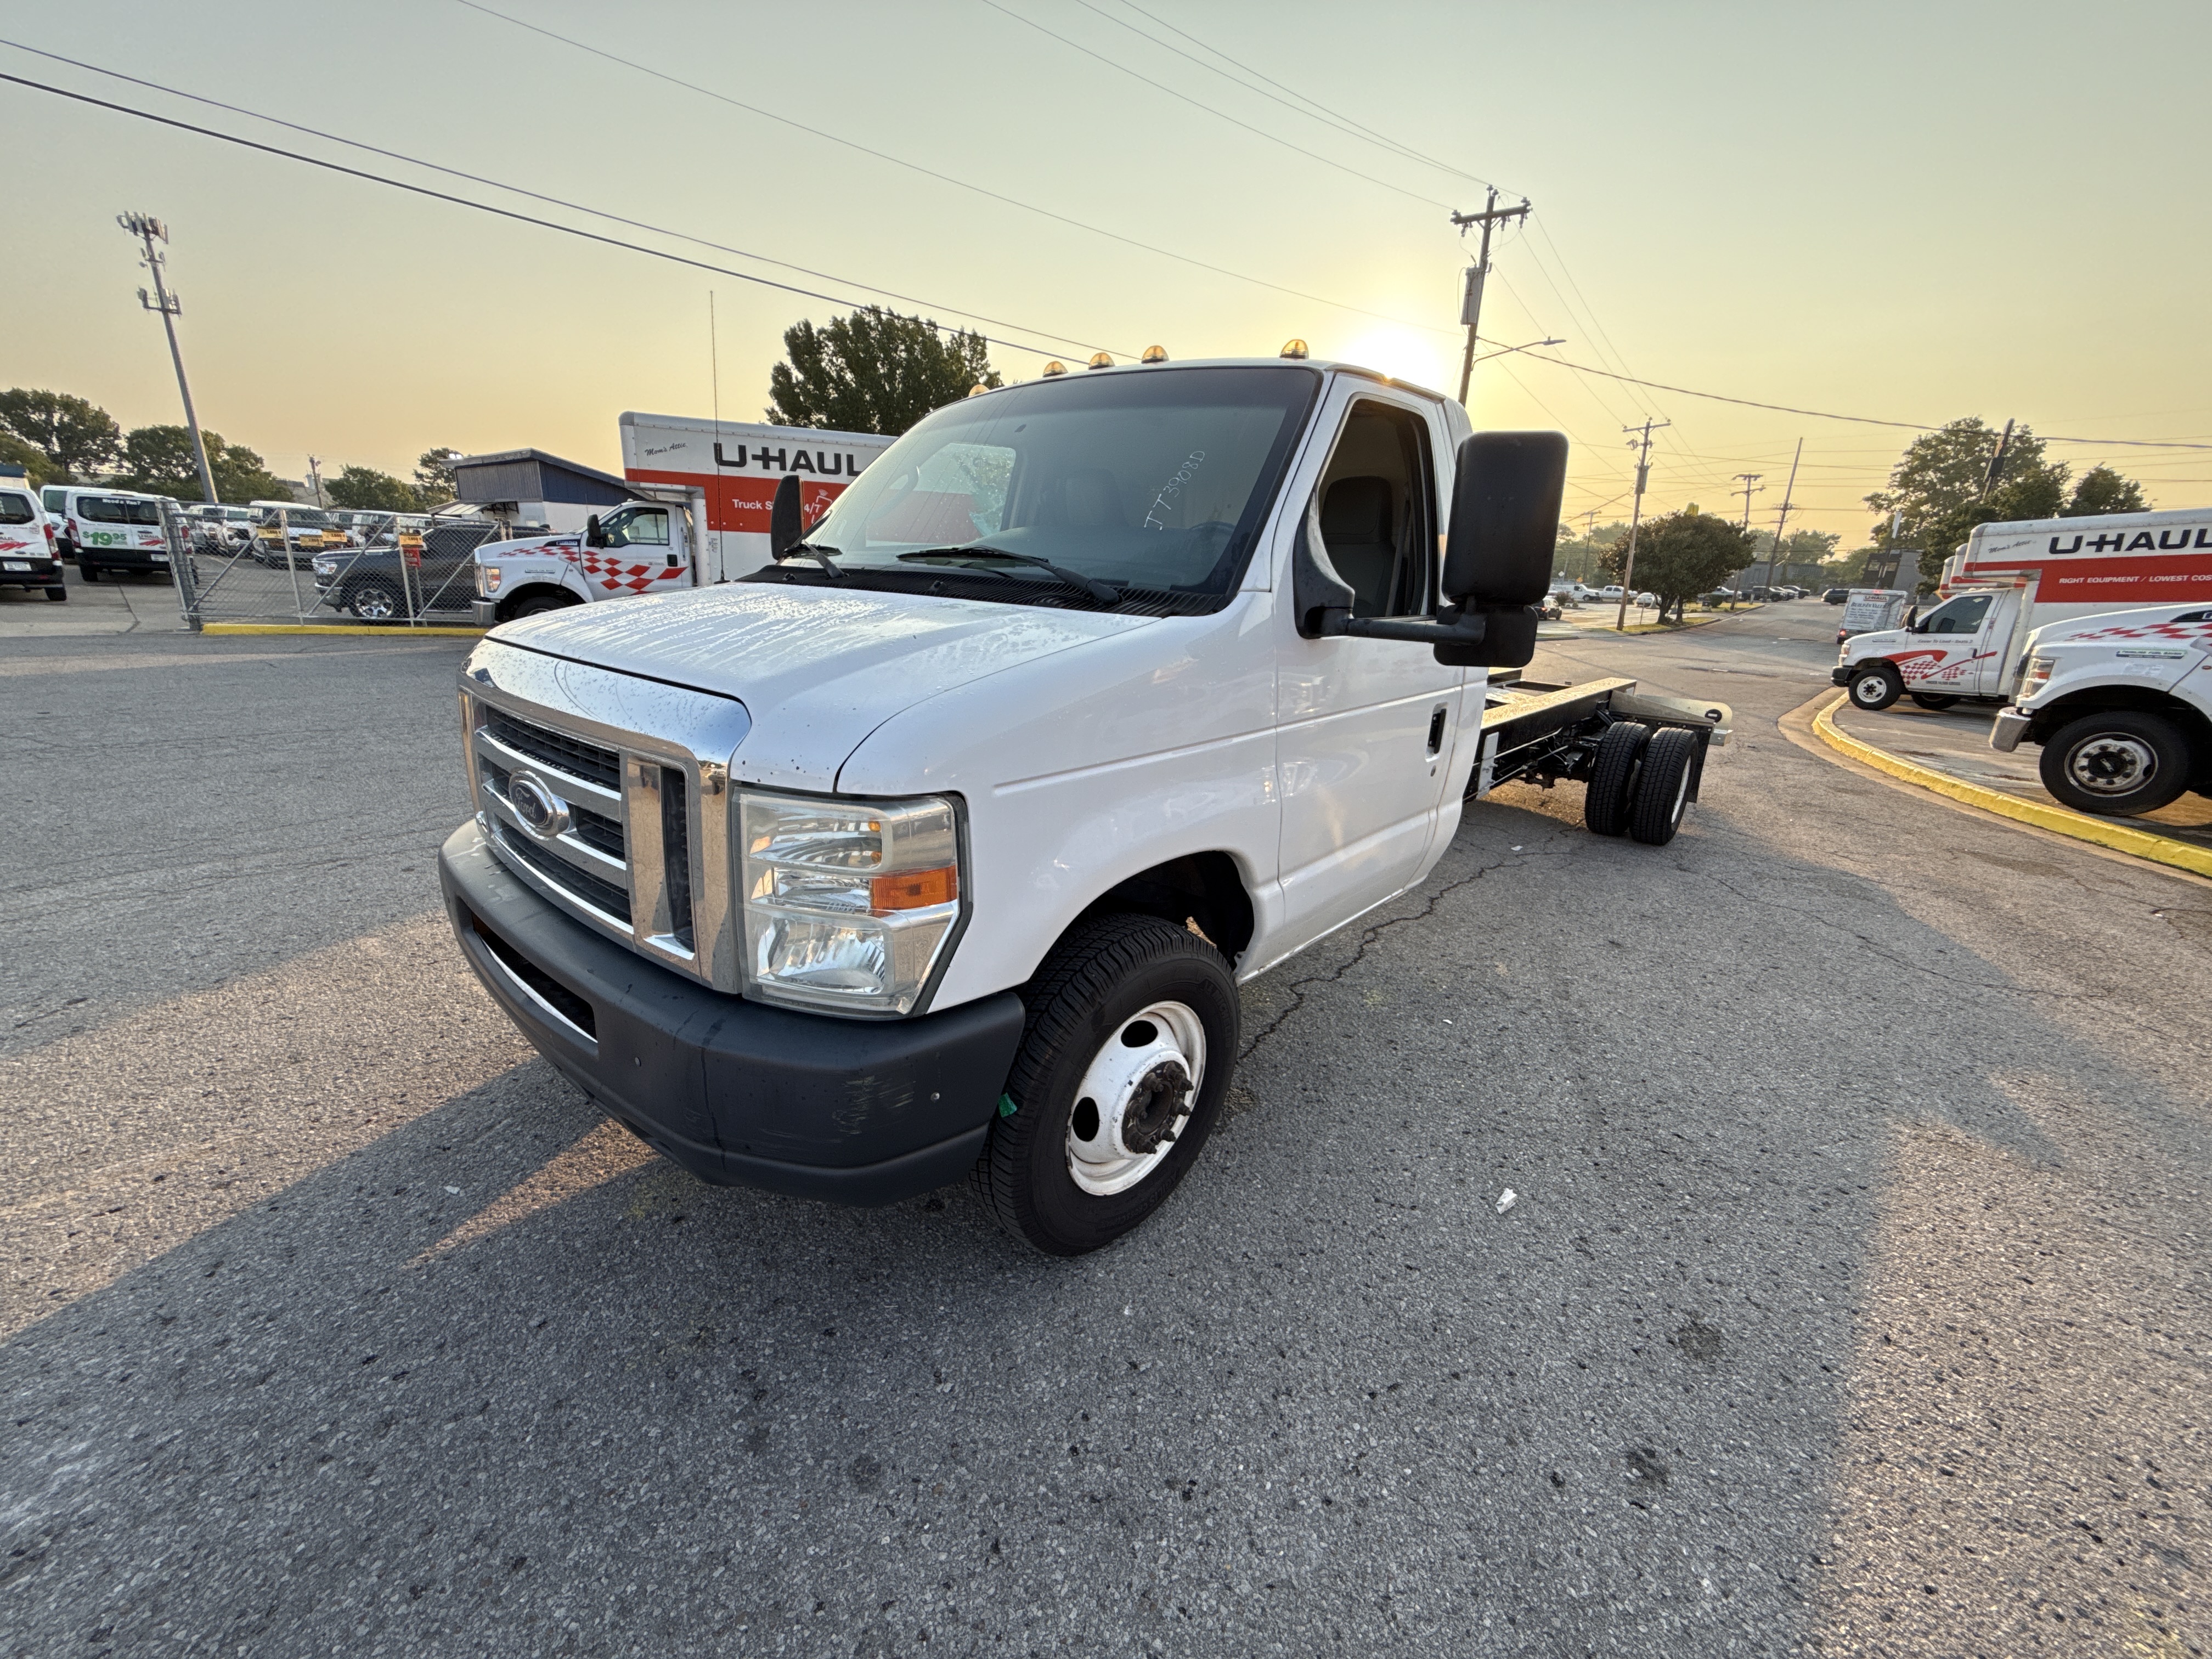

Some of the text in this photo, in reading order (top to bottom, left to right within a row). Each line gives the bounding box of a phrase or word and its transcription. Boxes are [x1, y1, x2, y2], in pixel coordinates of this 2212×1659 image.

[645, 442, 686, 456] Mom's Attic
[713, 442, 864, 477] U-HAUL
[732, 498, 763, 510] Truck
[804, 502, 821, 514] 4/7
[2049, 528, 2212, 555] U-HAUL
[514, 787, 537, 819] Ford
